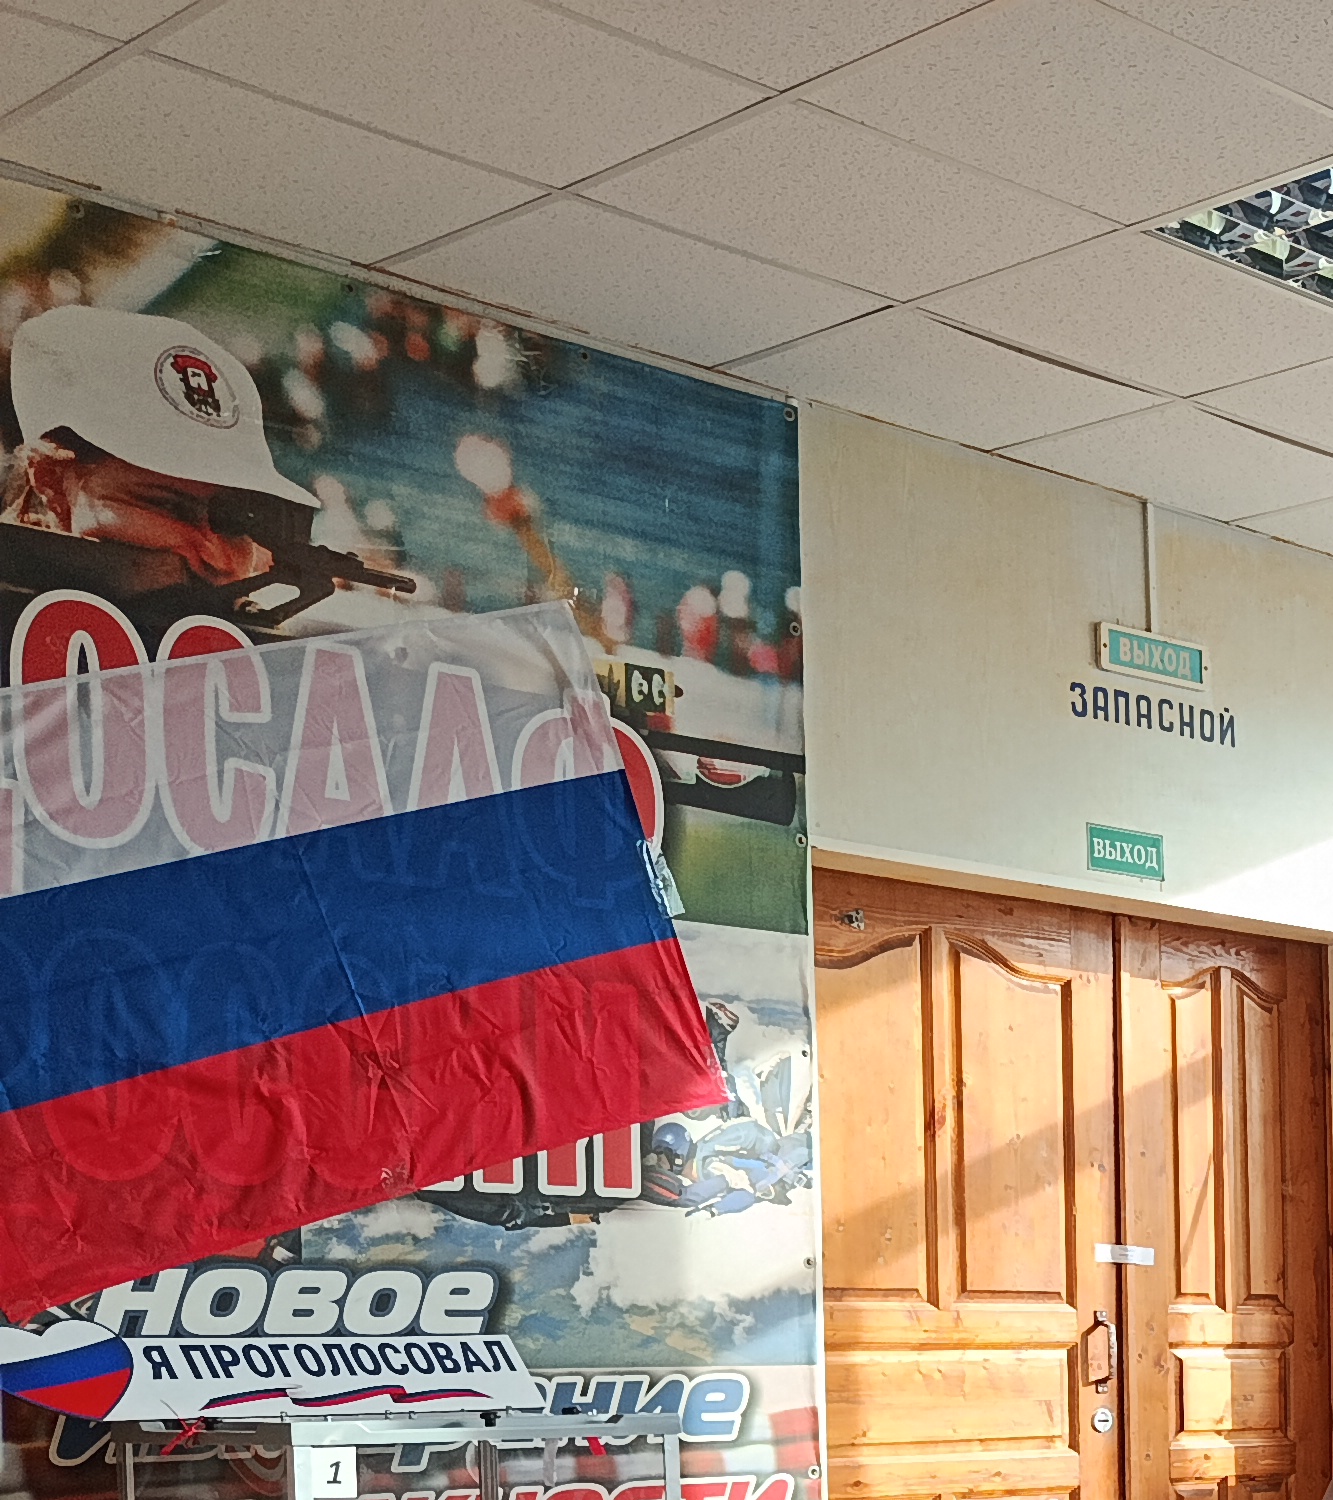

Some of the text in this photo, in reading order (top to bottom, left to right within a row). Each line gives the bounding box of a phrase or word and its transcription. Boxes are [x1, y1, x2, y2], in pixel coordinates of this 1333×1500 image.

[1118, 636, 1192, 680] ВЫХОД
[1069, 681, 1236, 748] ЗАПАСНОЙ
[1092, 836, 1159, 871] ВЫХОД
[143, 1341, 518, 1380] Я ПРОГОЛОСОВАЛ
[326, 1460, 342, 1485] 1
